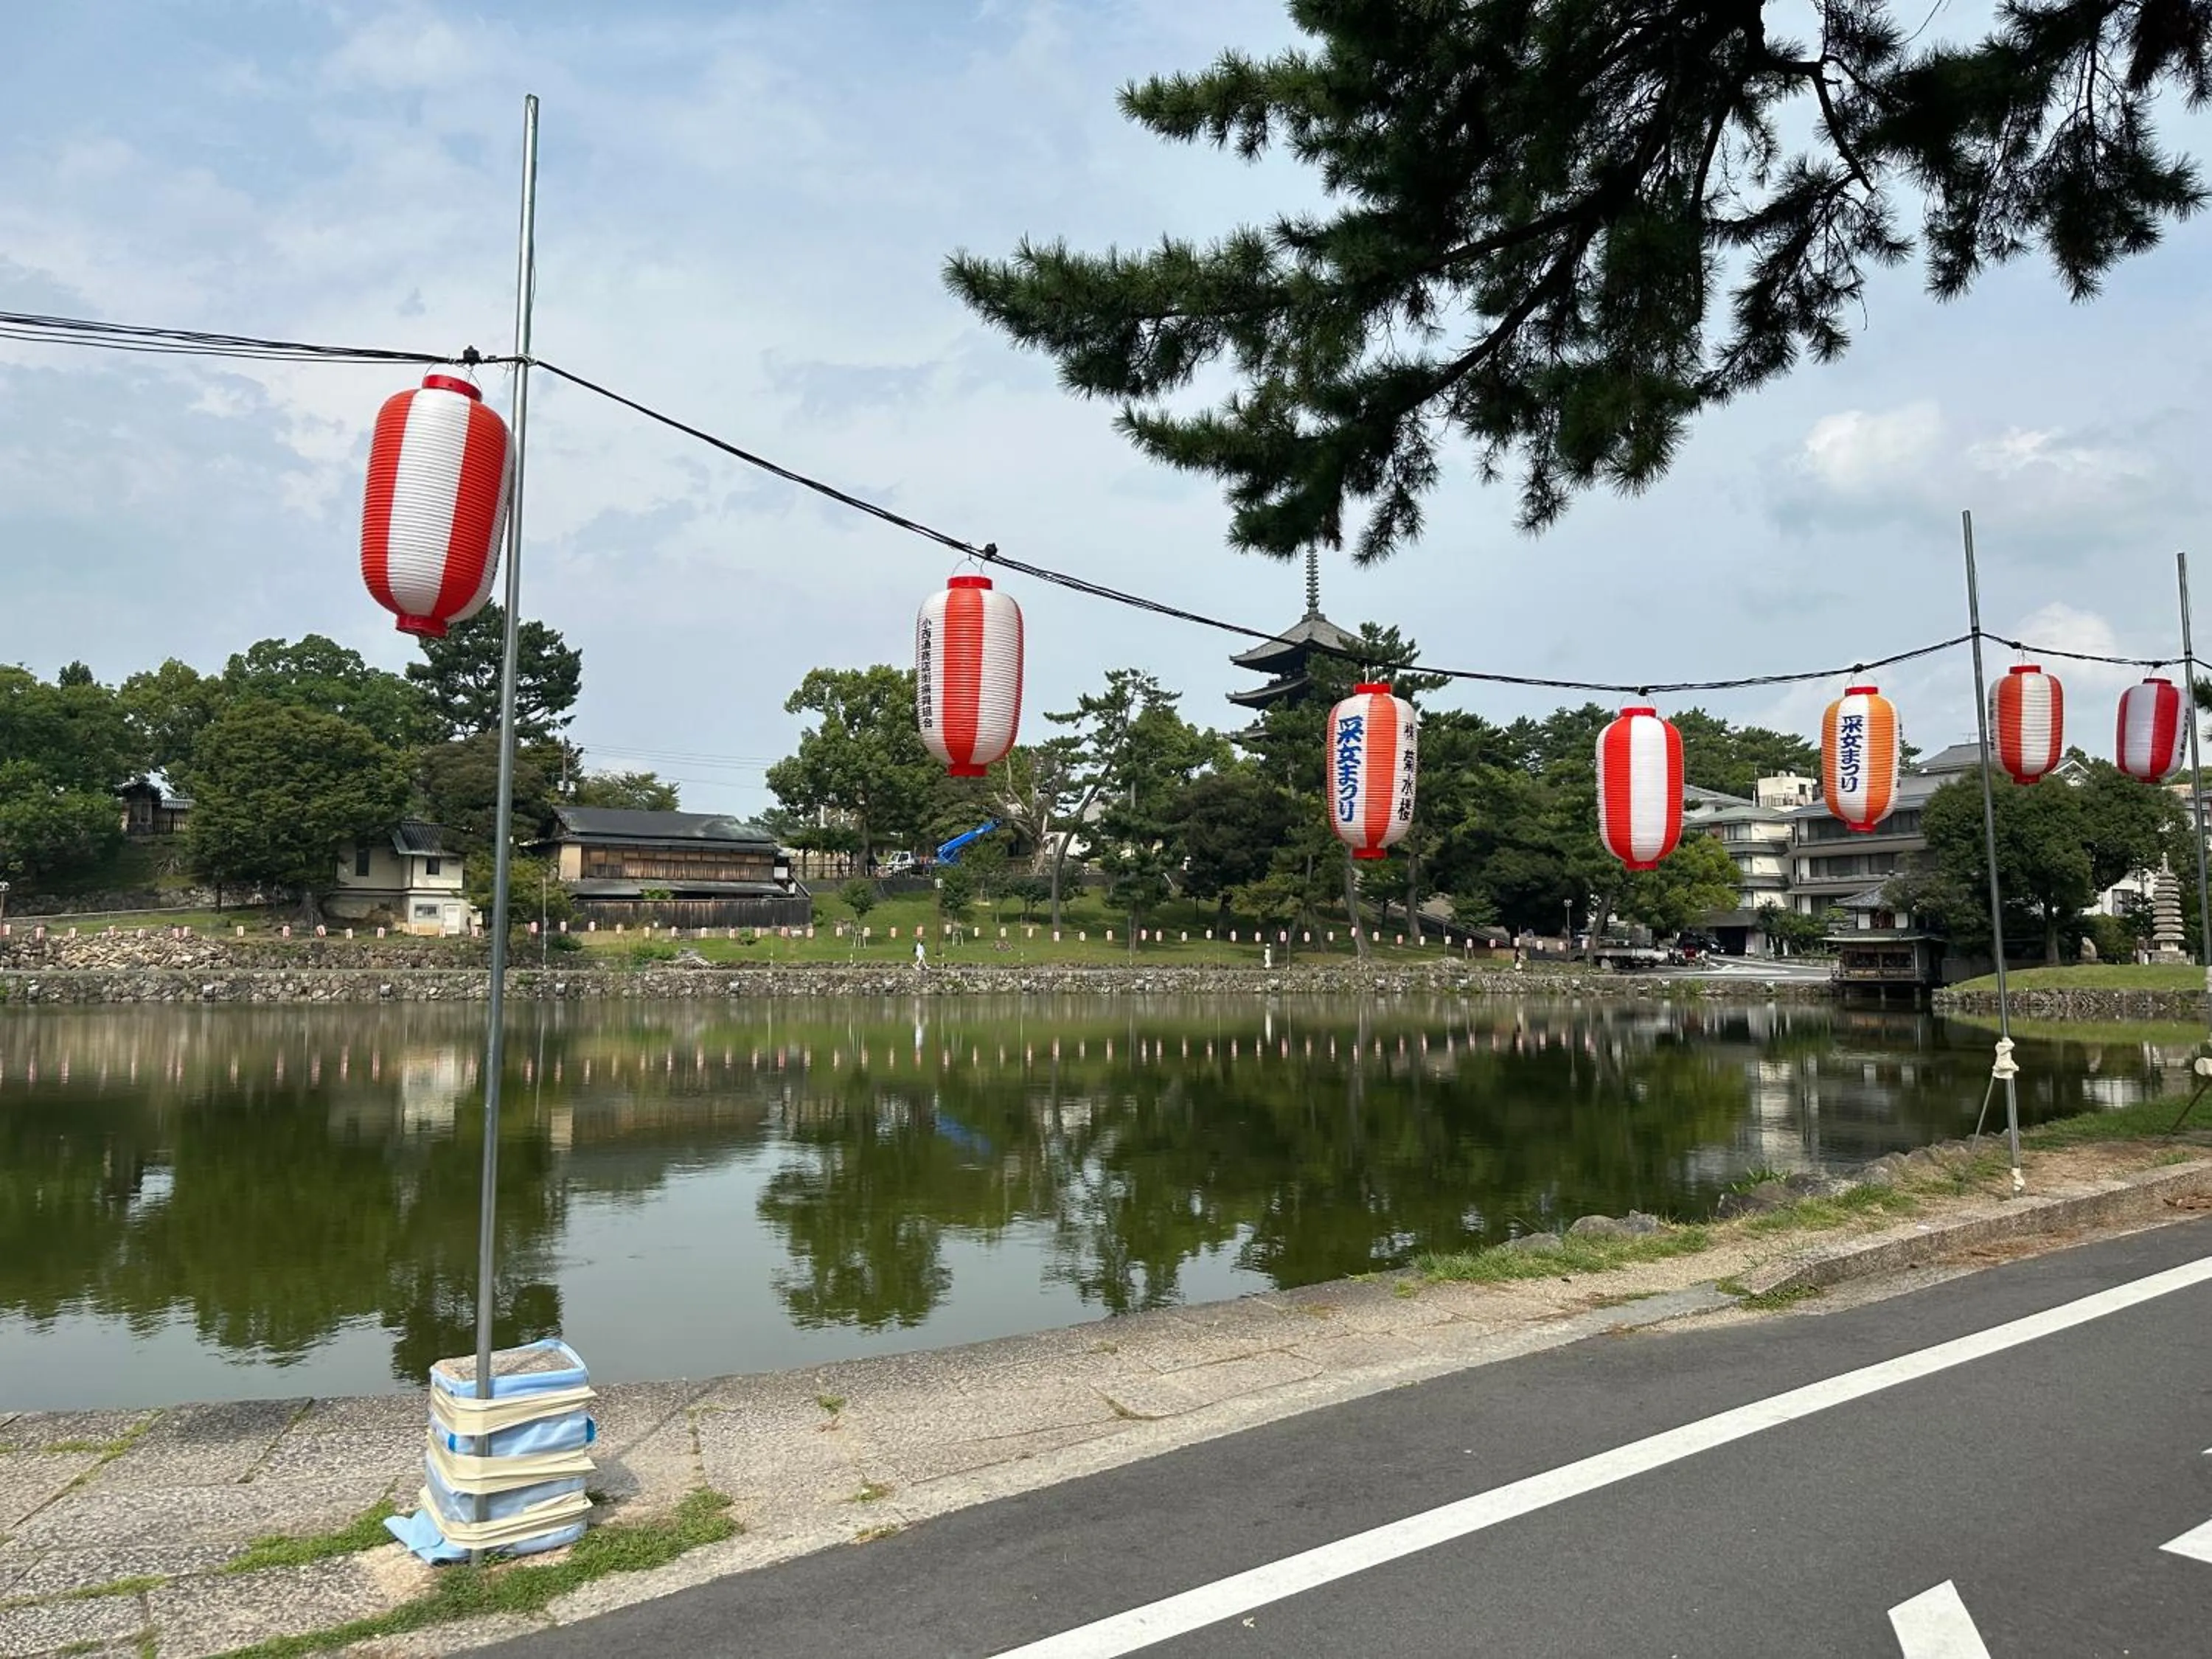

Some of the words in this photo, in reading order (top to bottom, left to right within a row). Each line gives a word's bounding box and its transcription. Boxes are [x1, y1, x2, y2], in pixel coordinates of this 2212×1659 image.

[1337, 715, 1364, 822] 采女まつり
[1840, 714, 1864, 793] 采女まつり
